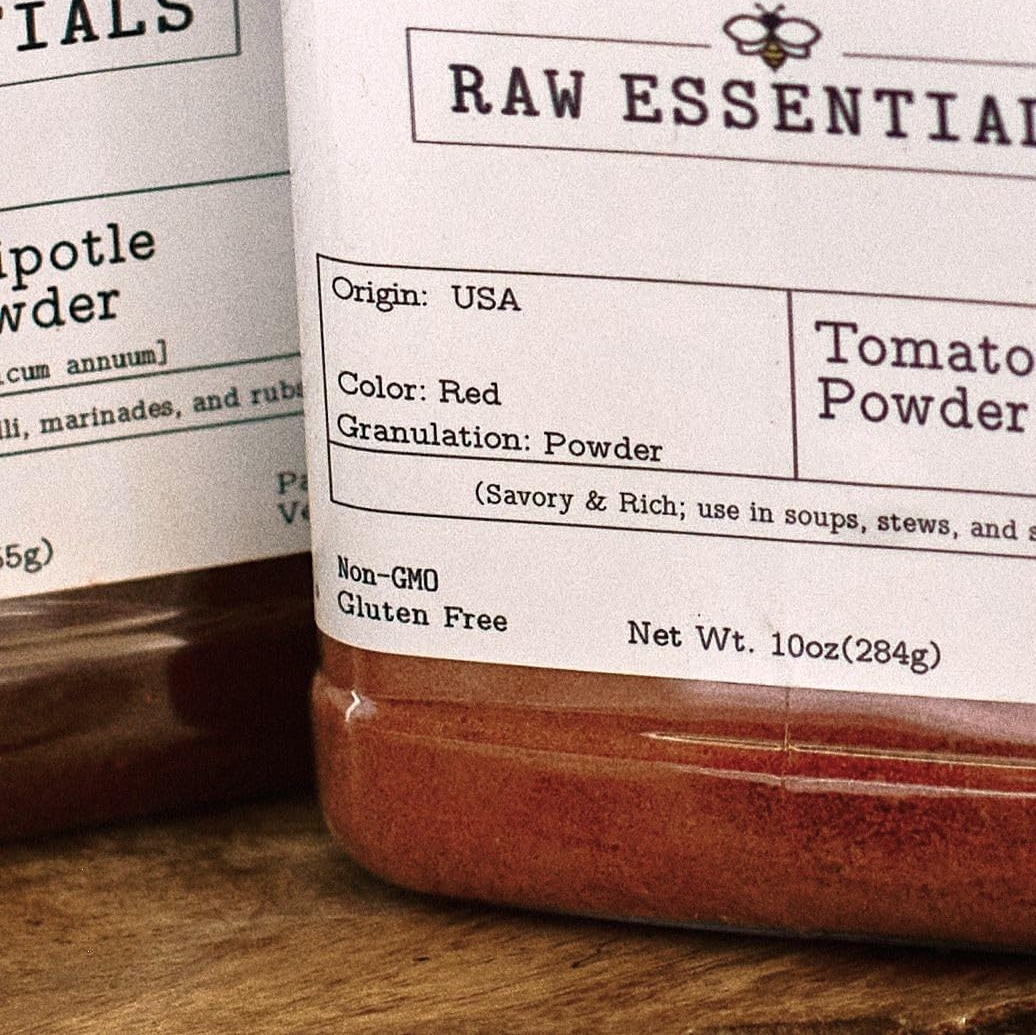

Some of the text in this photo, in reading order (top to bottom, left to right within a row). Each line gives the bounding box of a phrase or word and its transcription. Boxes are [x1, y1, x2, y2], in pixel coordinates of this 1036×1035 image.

[448, 63, 585, 119] RAW
[331, 275, 522, 312] Origin: USA
[66, 339, 169, 376] annuum]
[814, 319, 1036, 377] Tomato
[39, 398, 182, 435] marinades,
[193, 386, 241, 414] and
[337, 370, 502, 406] Color: Red
[817, 376, 1029, 434] Powder
[337, 413, 664, 463] Granulation: Powder
[475, 481, 574, 515] (Savory
[585, 490, 607, 512] &
[619, 491, 687, 522] Rich;
[698, 502, 740, 521] use
[749, 501, 775, 524] in
[784, 507, 868, 535] soups,
[877, 512, 959, 540] stews,
[970, 520, 1018, 541] and
[337, 555, 439, 592] Non-GMO
[337, 590, 508, 632] Gluten Free
[627, 620, 942, 675] Net Wt. 10oz(284g)
